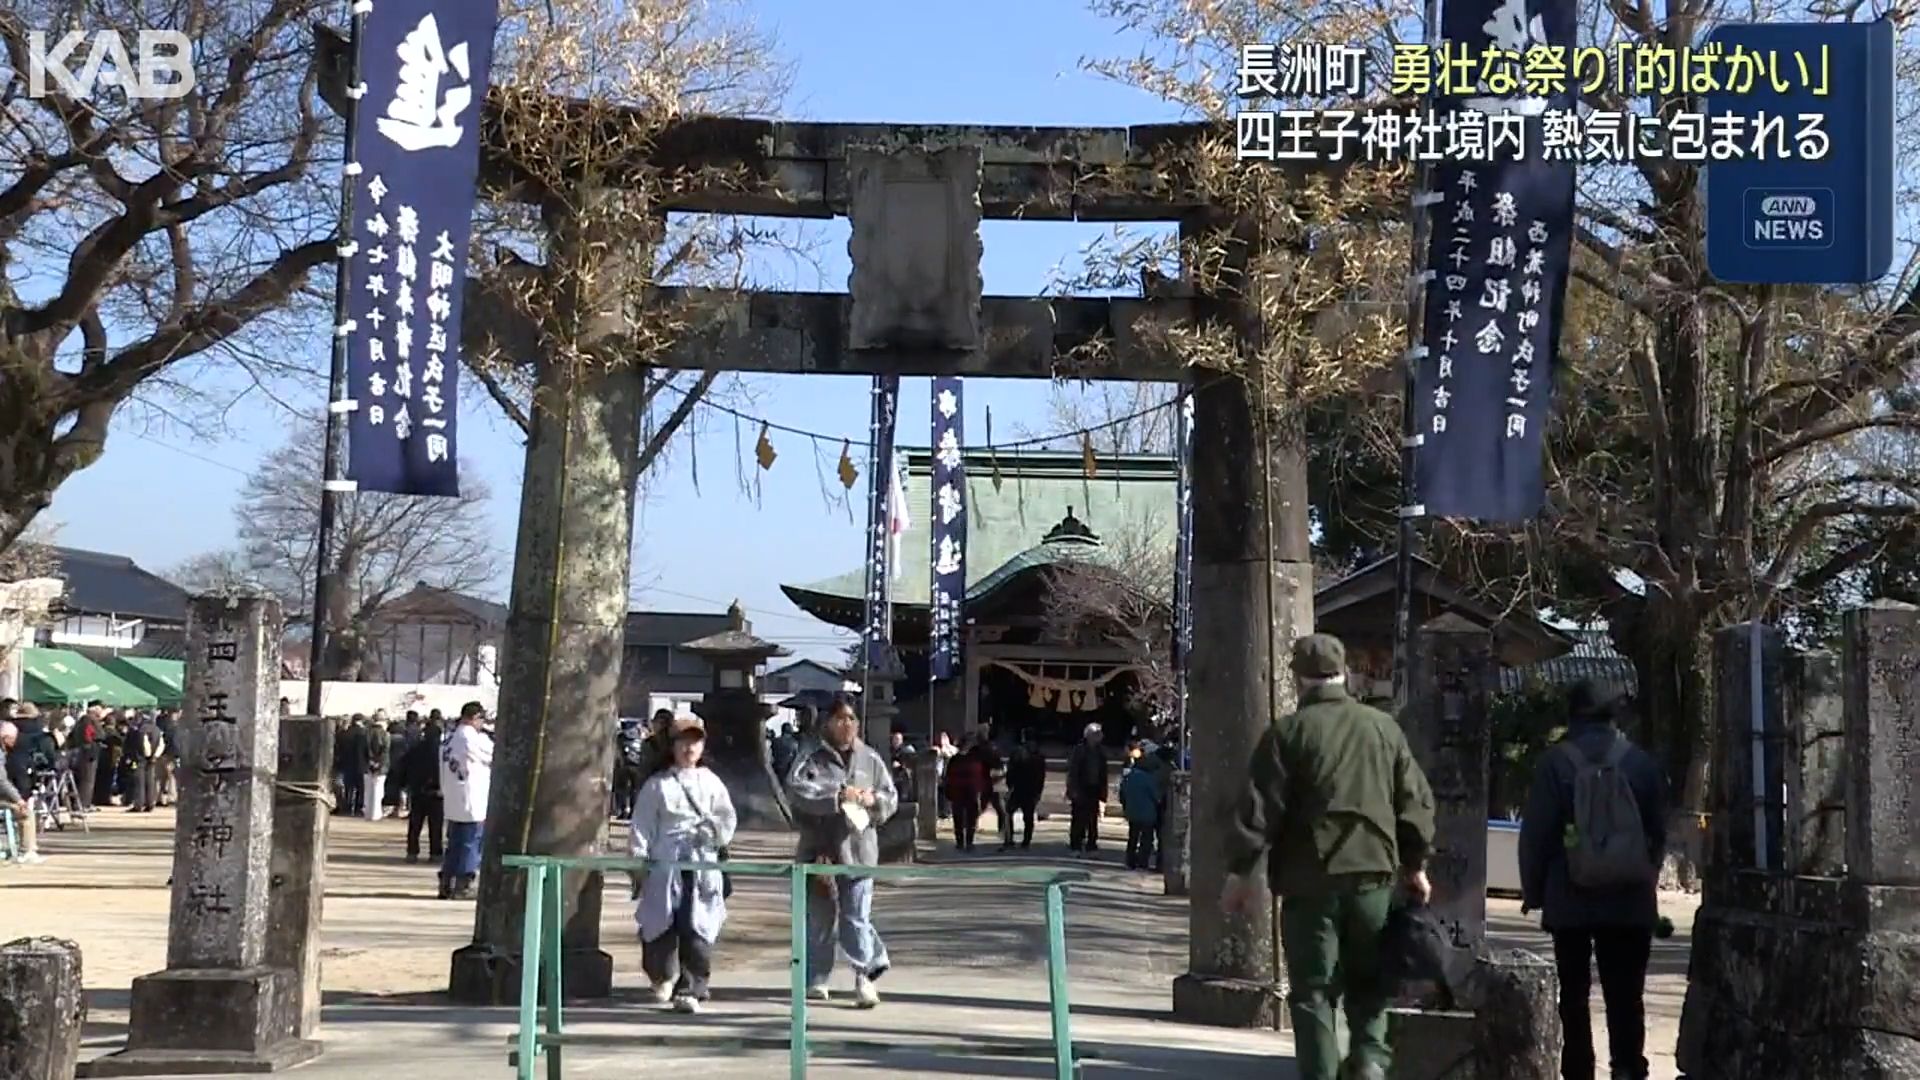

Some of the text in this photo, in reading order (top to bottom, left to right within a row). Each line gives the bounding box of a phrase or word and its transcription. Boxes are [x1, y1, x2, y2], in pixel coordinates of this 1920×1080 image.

[192, 641, 238, 915] 四王子神社
